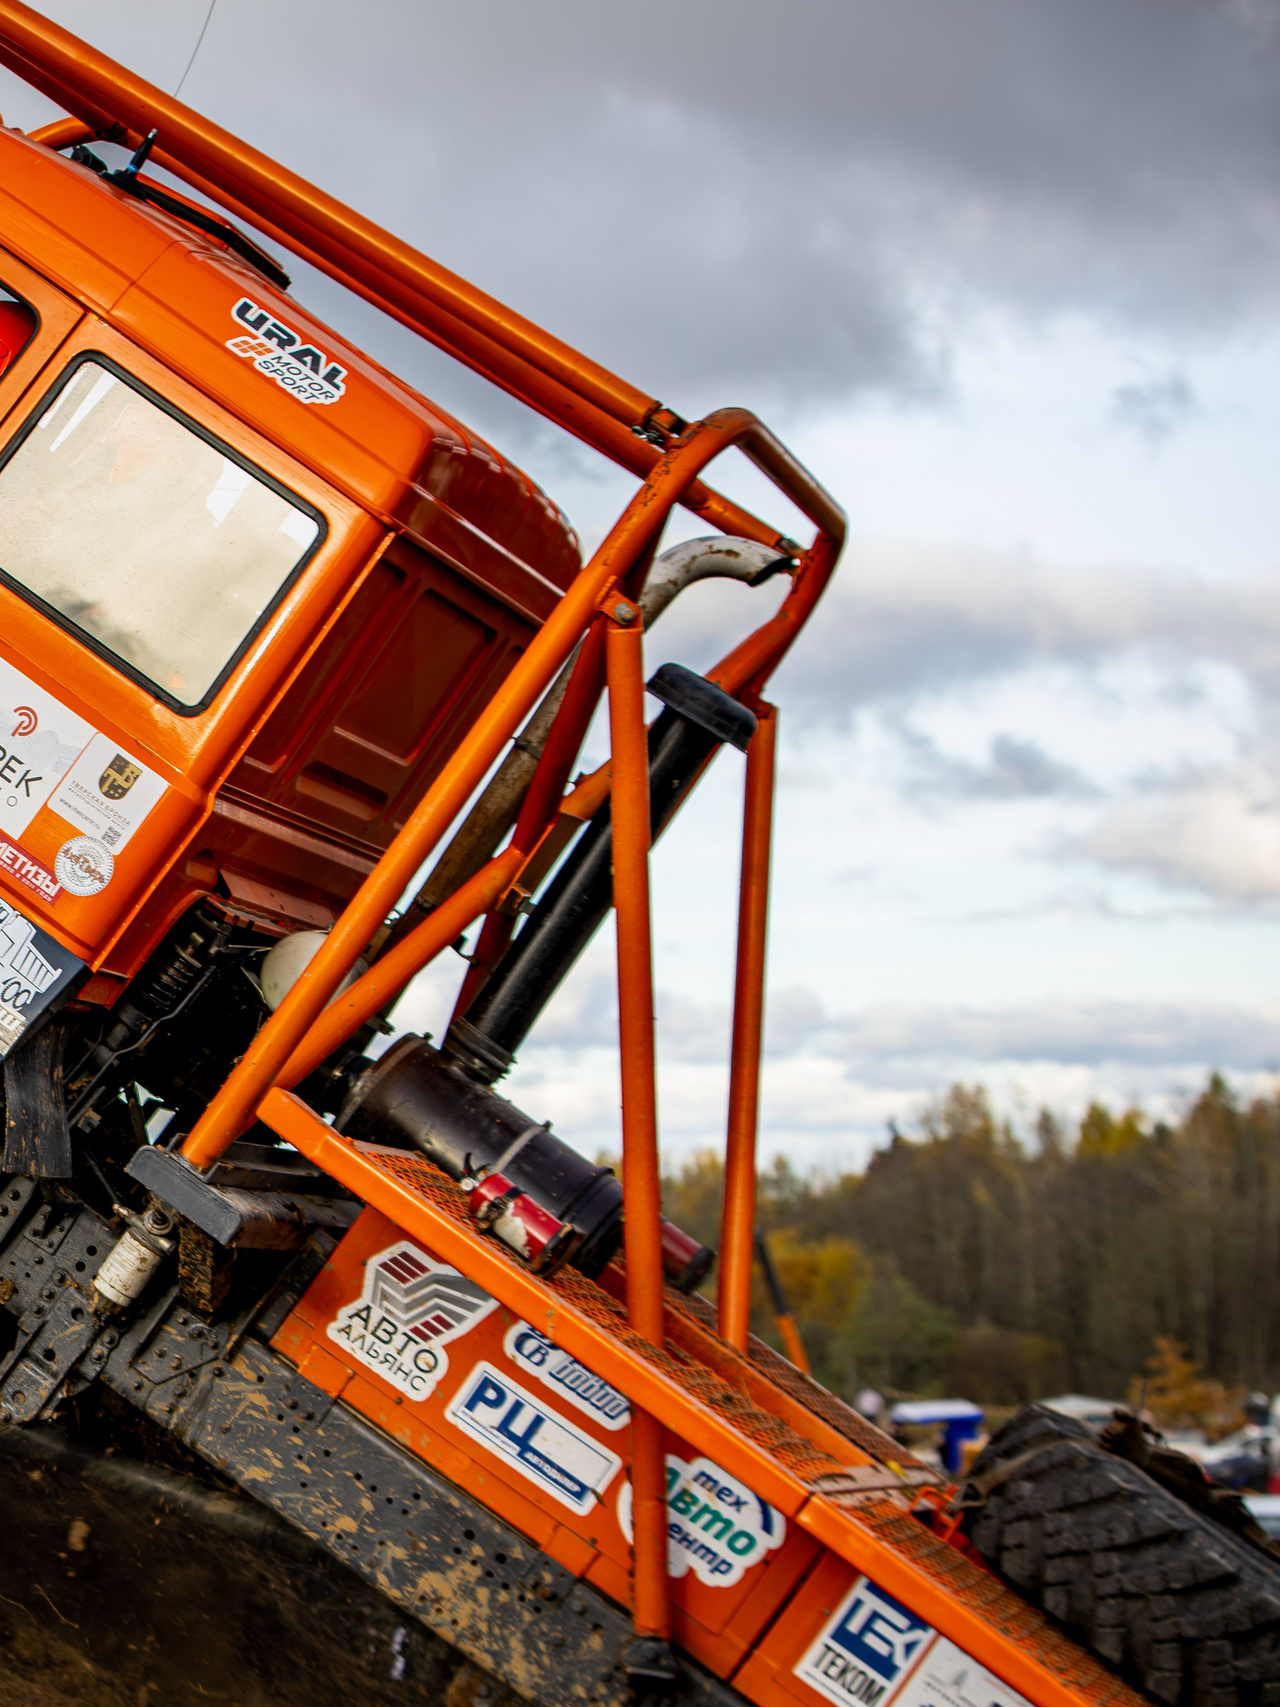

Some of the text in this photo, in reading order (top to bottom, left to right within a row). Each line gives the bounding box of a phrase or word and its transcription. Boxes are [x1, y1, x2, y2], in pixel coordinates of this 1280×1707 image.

[236, 301, 343, 391] URAL
[258, 360, 320, 400] SPORT
[271, 356, 335, 400] MOTOR
[337, 1323, 427, 1391] АЛЬЯНС
[347, 1304, 438, 1374] АВТО
